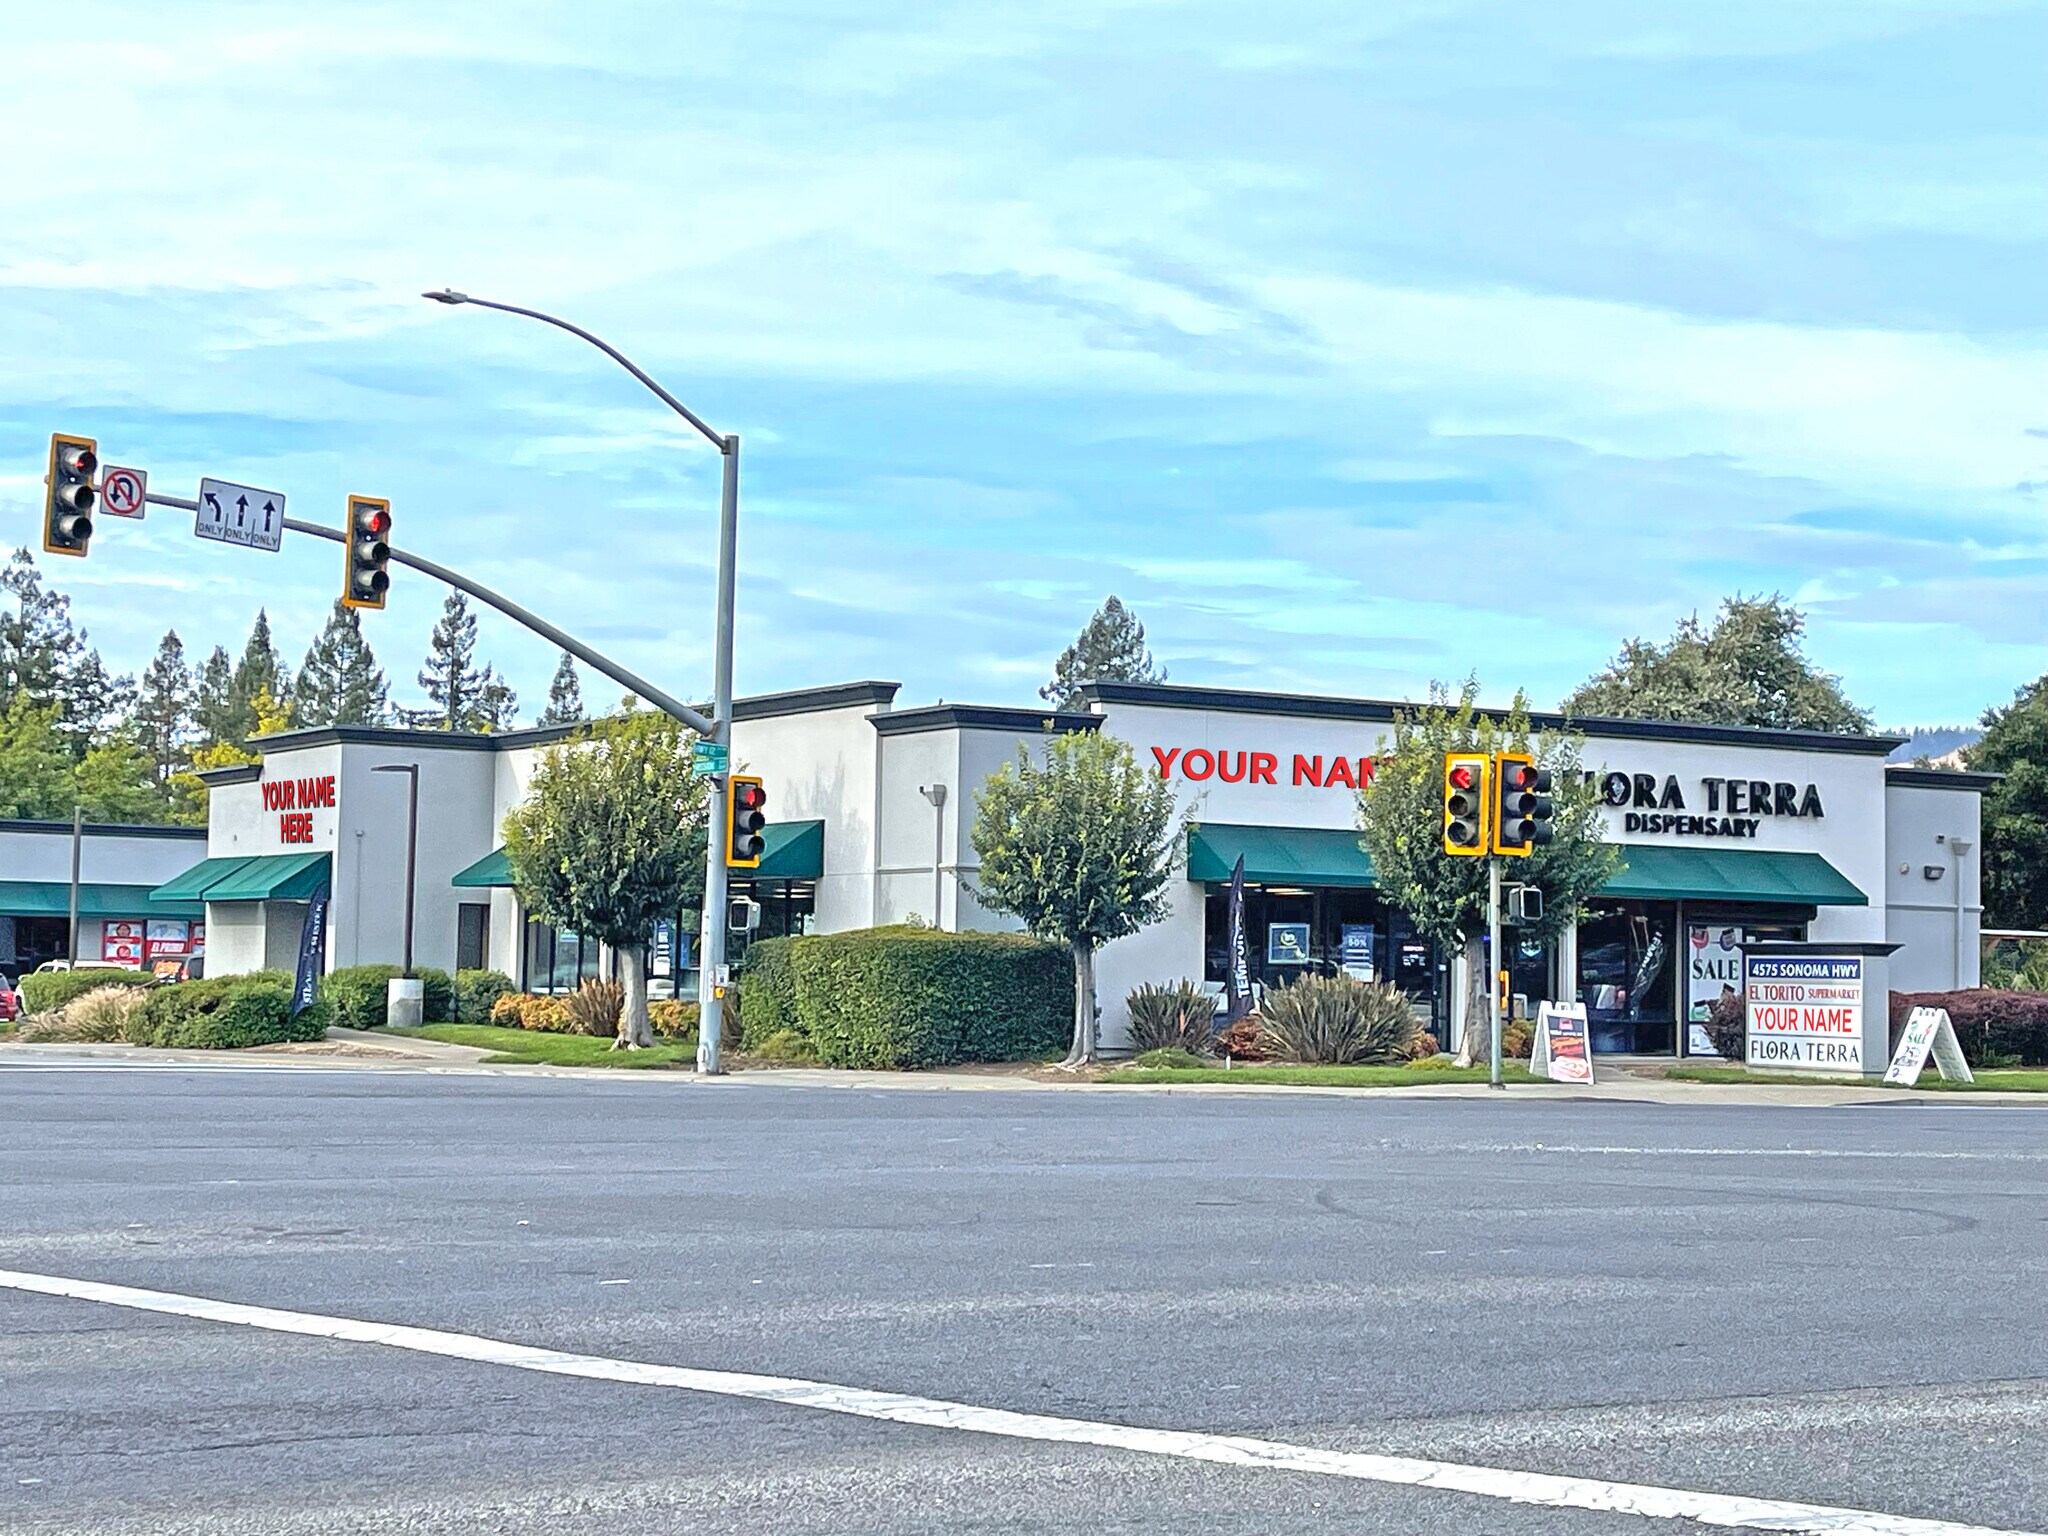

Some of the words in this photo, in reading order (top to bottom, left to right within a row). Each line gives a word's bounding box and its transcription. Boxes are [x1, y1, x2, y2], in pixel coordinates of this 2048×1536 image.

[199, 523, 223, 535] ONLY
[226, 528, 251, 541] ONLY
[253, 534, 279, 546] ONLY
[1151, 746, 1278, 785] YOUR
[261, 780, 296, 811] YOUR
[297, 776, 335, 809] NAME
[1701, 777, 1825, 818] TERRA
[280, 813, 313, 843] HERE
[1625, 812, 1761, 838] DISPENSARY
[1692, 958, 1740, 980] SALE
[1752, 963, 1778, 976] 4575
[1780, 963, 1829, 977] SONOMA
[1832, 965, 1858, 978] HWY
[1749, 985, 1760, 1000] EL
[1763, 985, 1805, 1001] TORITO
[1808, 988, 1860, 999] SUPERMARKET
[1754, 1007, 1798, 1031] YOUR
[1804, 1008, 1852, 1033] NAME
[1751, 1041, 1801, 1060] FLORA
[1806, 1042, 1859, 1063] TERRA
